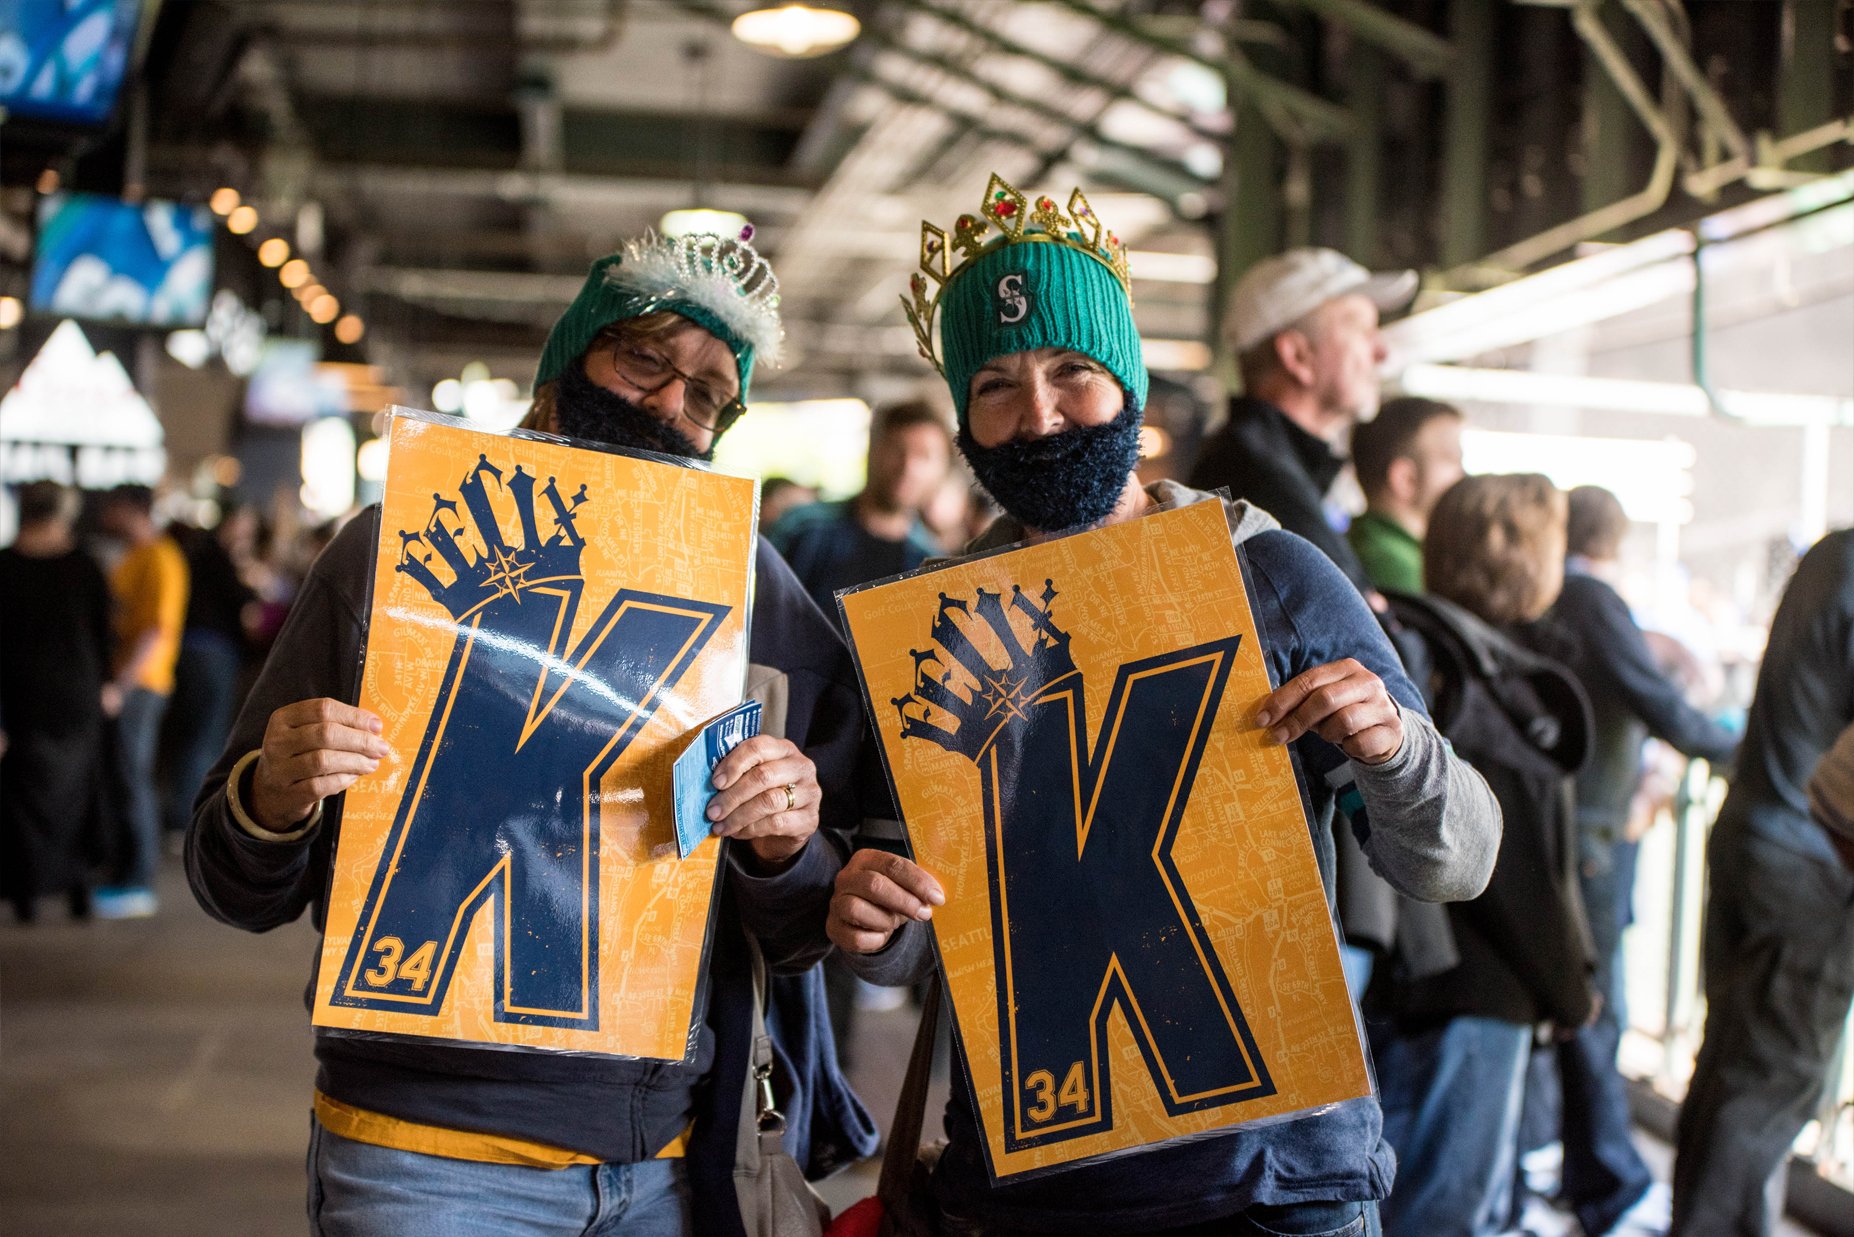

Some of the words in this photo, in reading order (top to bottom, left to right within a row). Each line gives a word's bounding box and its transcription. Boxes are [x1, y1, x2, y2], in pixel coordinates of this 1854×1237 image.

[998, 275, 1027, 323] S
[329, 578, 733, 1031] K
[981, 634, 1277, 1154] K
[364, 935, 438, 991] 34
[1025, 1061, 1089, 1122] 34
